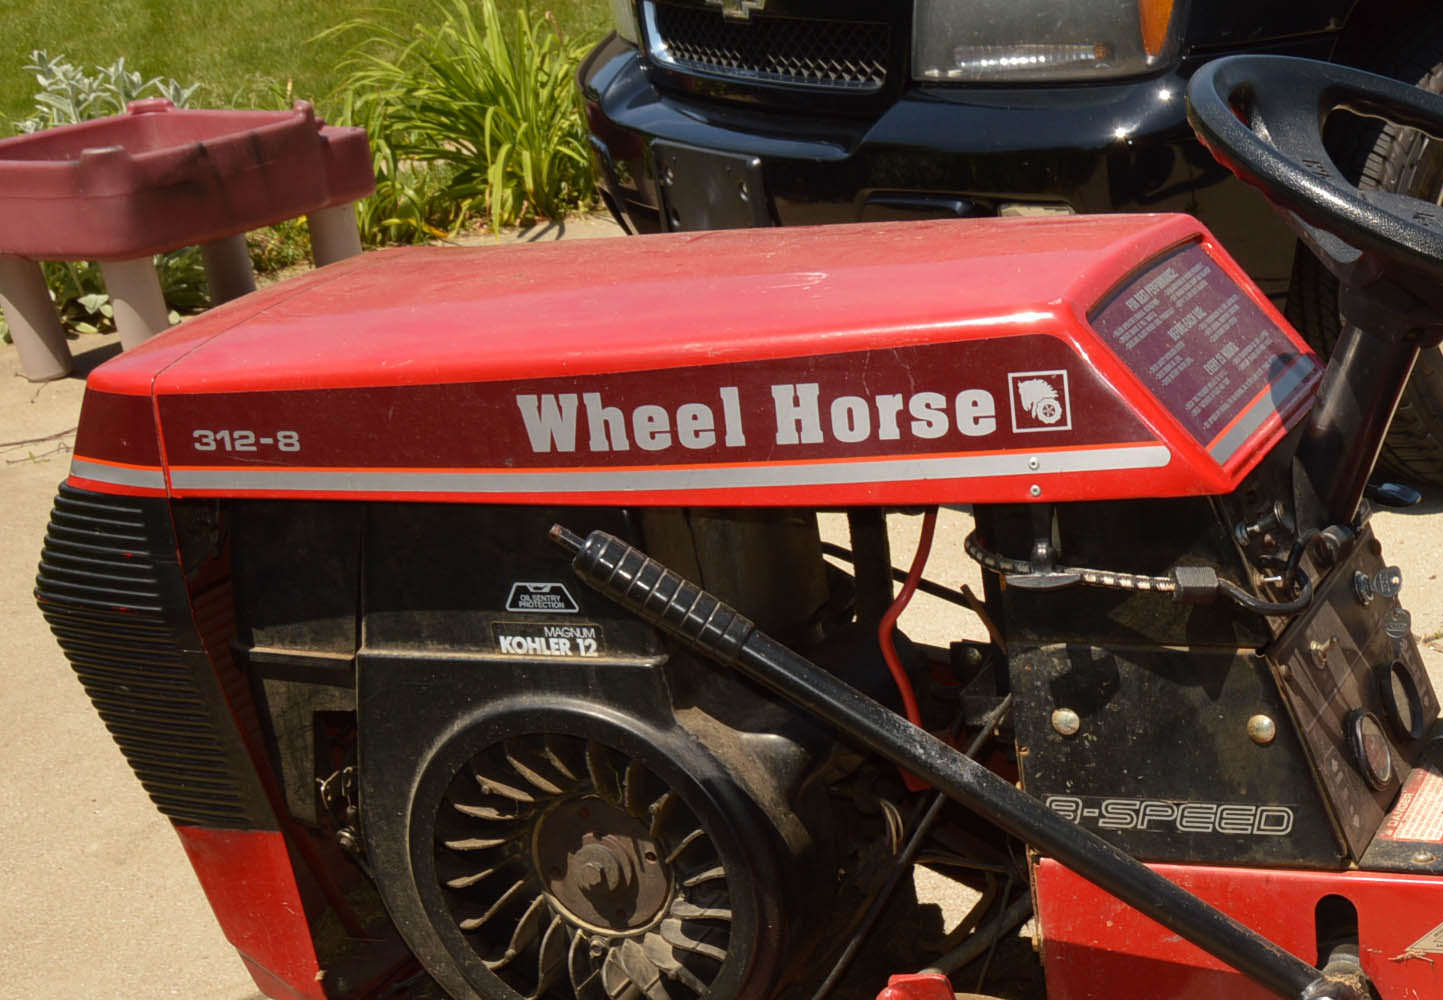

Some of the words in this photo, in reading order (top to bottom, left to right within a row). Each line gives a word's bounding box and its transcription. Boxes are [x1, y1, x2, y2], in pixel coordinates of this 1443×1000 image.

[517, 386, 746, 452] Wheel
[771, 382, 997, 446] Horse
[193, 430, 300, 452] 312-8
[519, 601, 565, 609] PROTECTION
[544, 626, 596, 638] MAGNUM
[499, 635, 573, 656] KOHLER
[576, 638, 599, 657] 12
